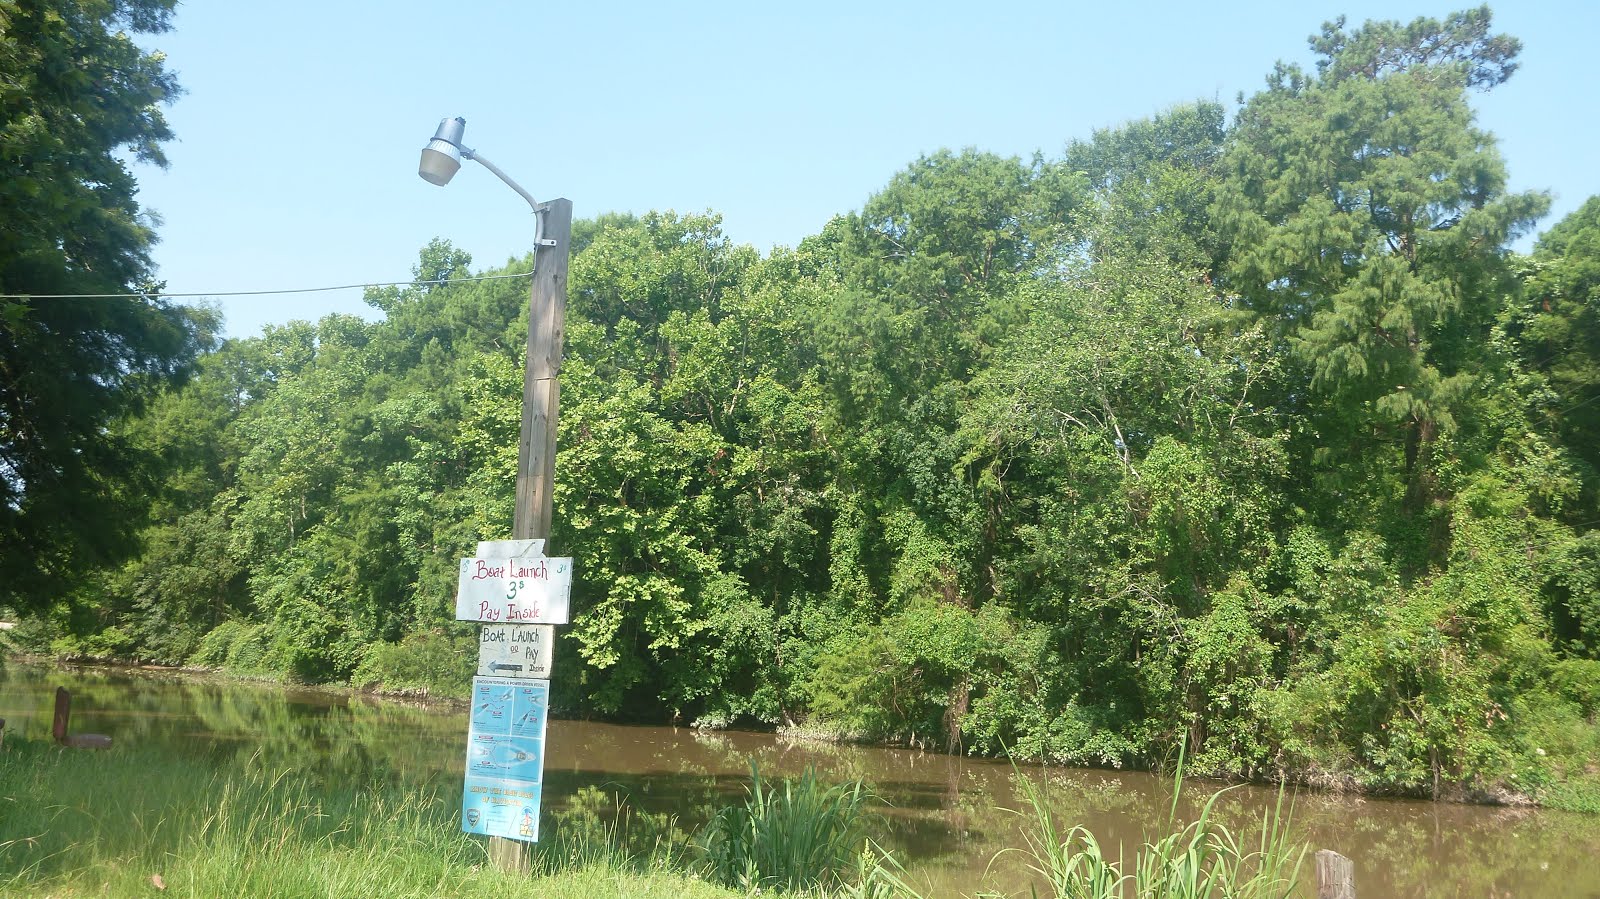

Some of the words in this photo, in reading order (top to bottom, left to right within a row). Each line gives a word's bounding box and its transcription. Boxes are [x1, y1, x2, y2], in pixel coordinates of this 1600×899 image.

[472, 559, 505, 580] Boat
[510, 558, 548, 580] Launch
[478, 600, 501, 621] Pay
[506, 600, 540, 620] Inside
